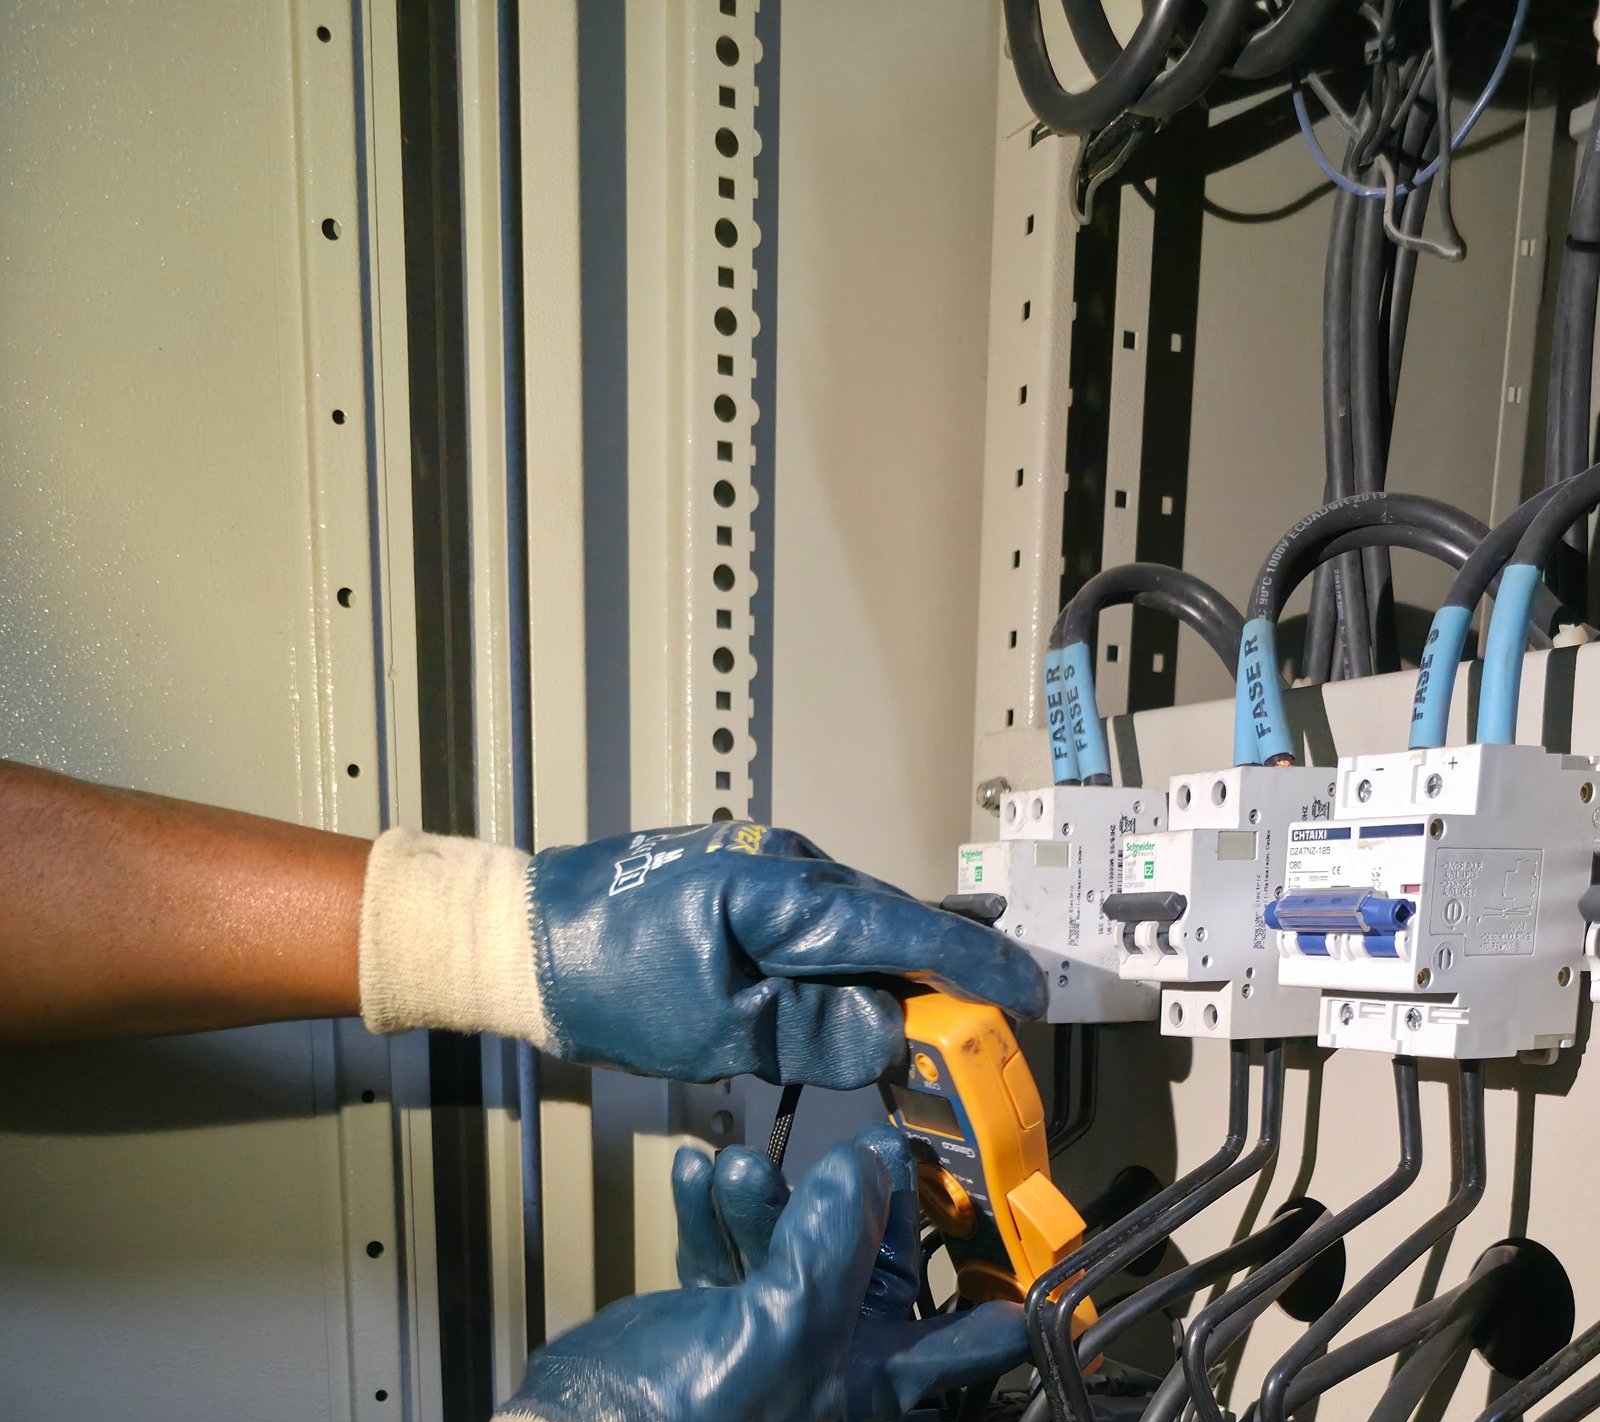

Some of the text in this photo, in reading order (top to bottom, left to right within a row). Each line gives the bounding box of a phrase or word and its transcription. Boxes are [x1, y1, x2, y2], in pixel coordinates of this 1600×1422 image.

[1287, 498, 1350, 540] ECUADOR
[1046, 665, 1068, 761] FASE R
[1064, 664, 1088, 753] FASE S
[1244, 634, 1272, 739] FASE R
[1126, 842, 1155, 853] Schneider
[1293, 829, 1327, 841] CHTAIXI
